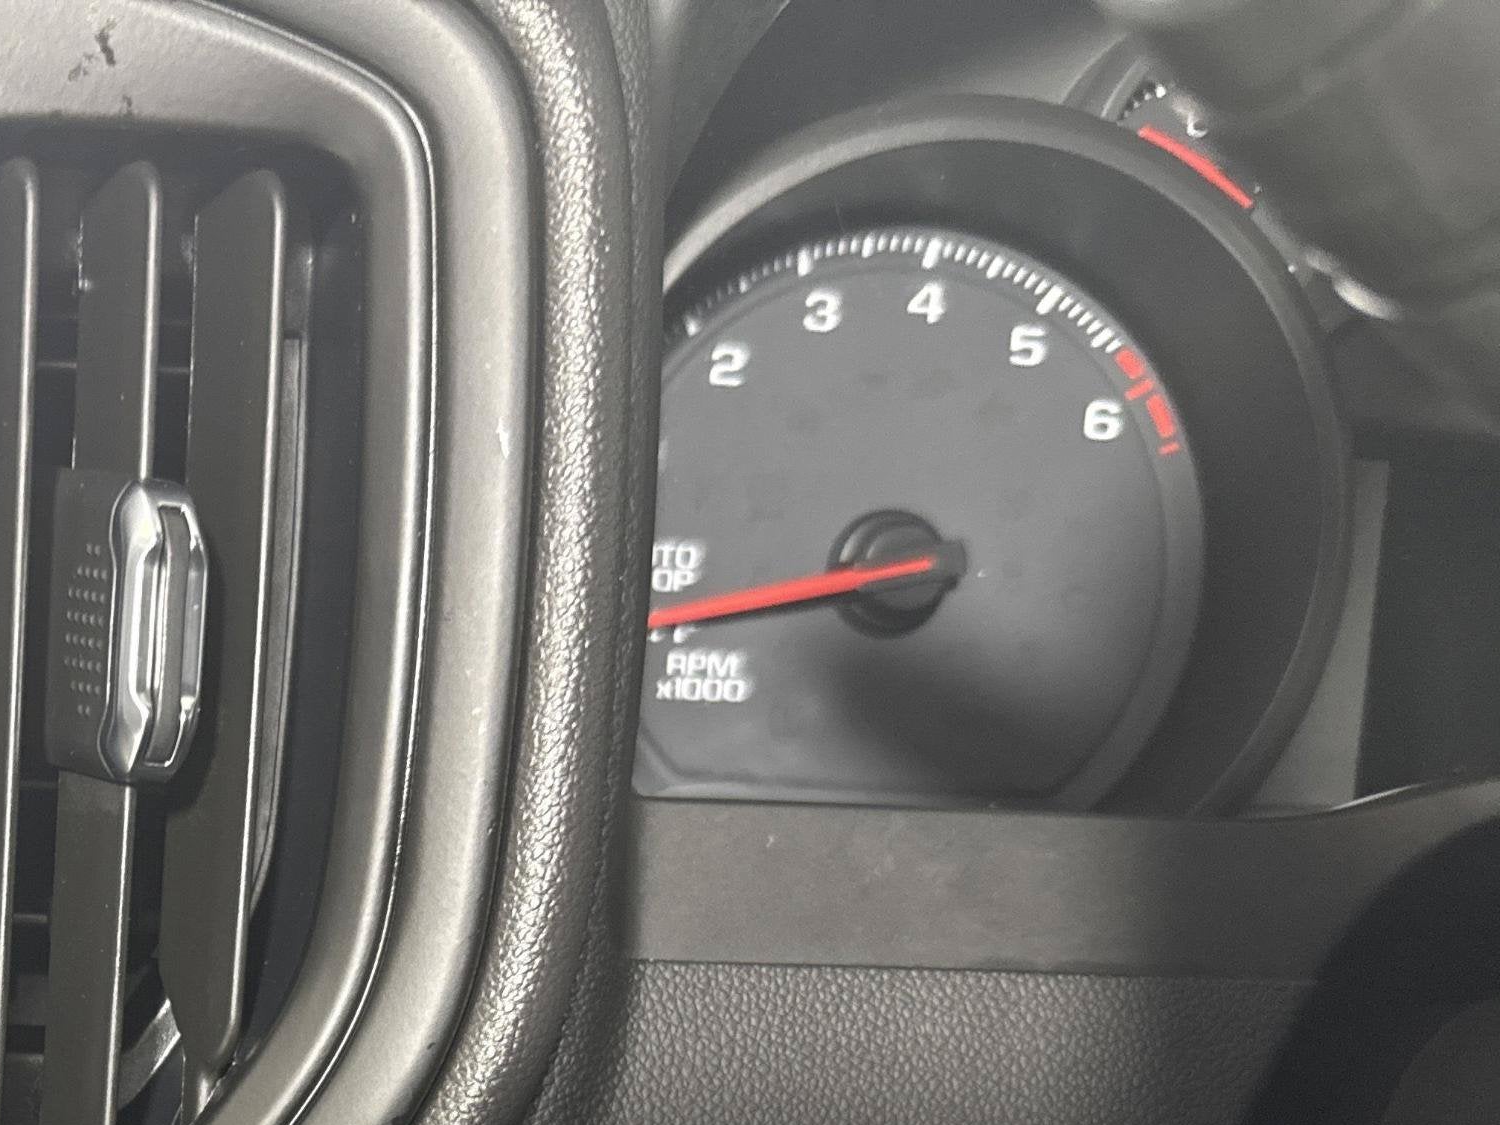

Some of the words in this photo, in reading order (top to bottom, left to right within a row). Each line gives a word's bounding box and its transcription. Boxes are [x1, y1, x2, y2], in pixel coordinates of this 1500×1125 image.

[803, 288, 843, 332] 3
[906, 281, 946, 324] 4
[709, 344, 749, 388] 2
[1009, 324, 1047, 366] 5
[1083, 400, 1124, 441] 6
[666, 652, 740, 678] RPM
